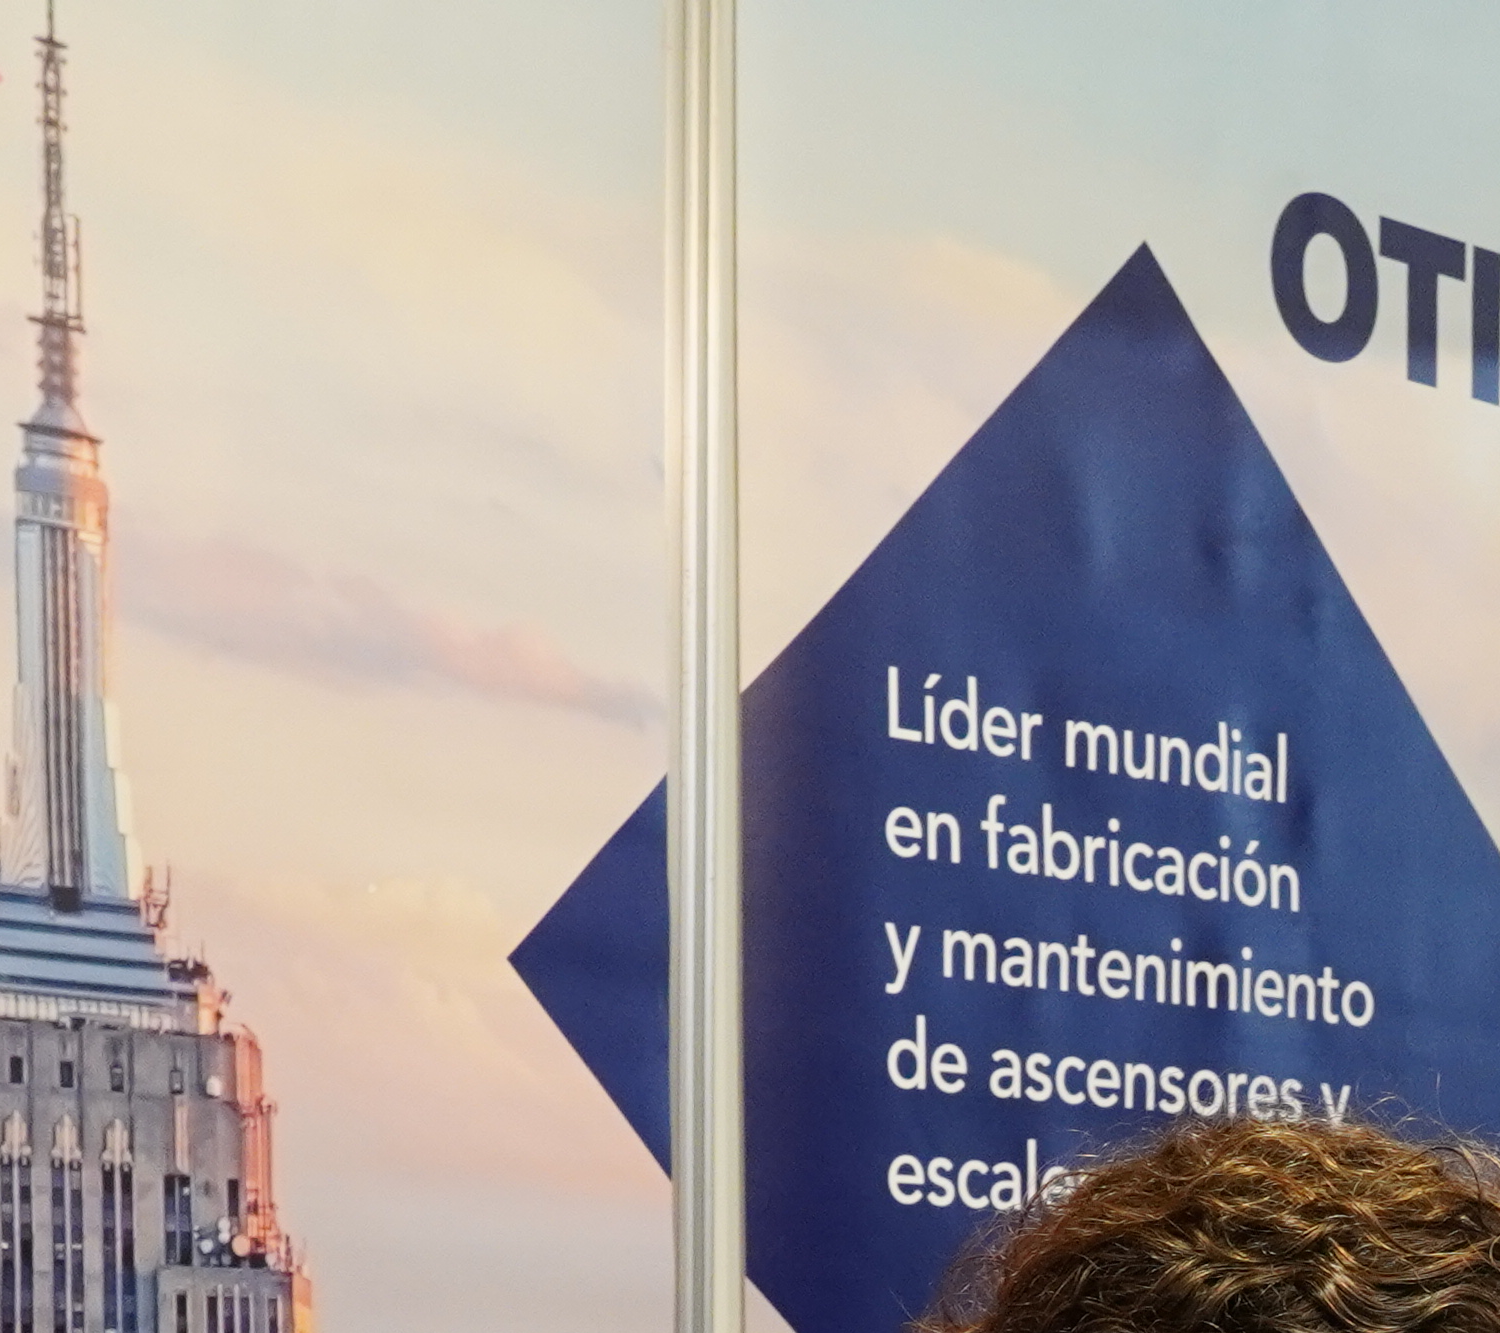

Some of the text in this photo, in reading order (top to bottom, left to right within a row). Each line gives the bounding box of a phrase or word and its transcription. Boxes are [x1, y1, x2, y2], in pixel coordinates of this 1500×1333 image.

[888, 665, 1288, 803] Líder mundial
[885, 794, 1300, 912] en fabricación
[885, 922, 1375, 1027] y mantenimiento
[887, 1014, 968, 1094] de
[989, 1048, 1303, 1122] ascensores
